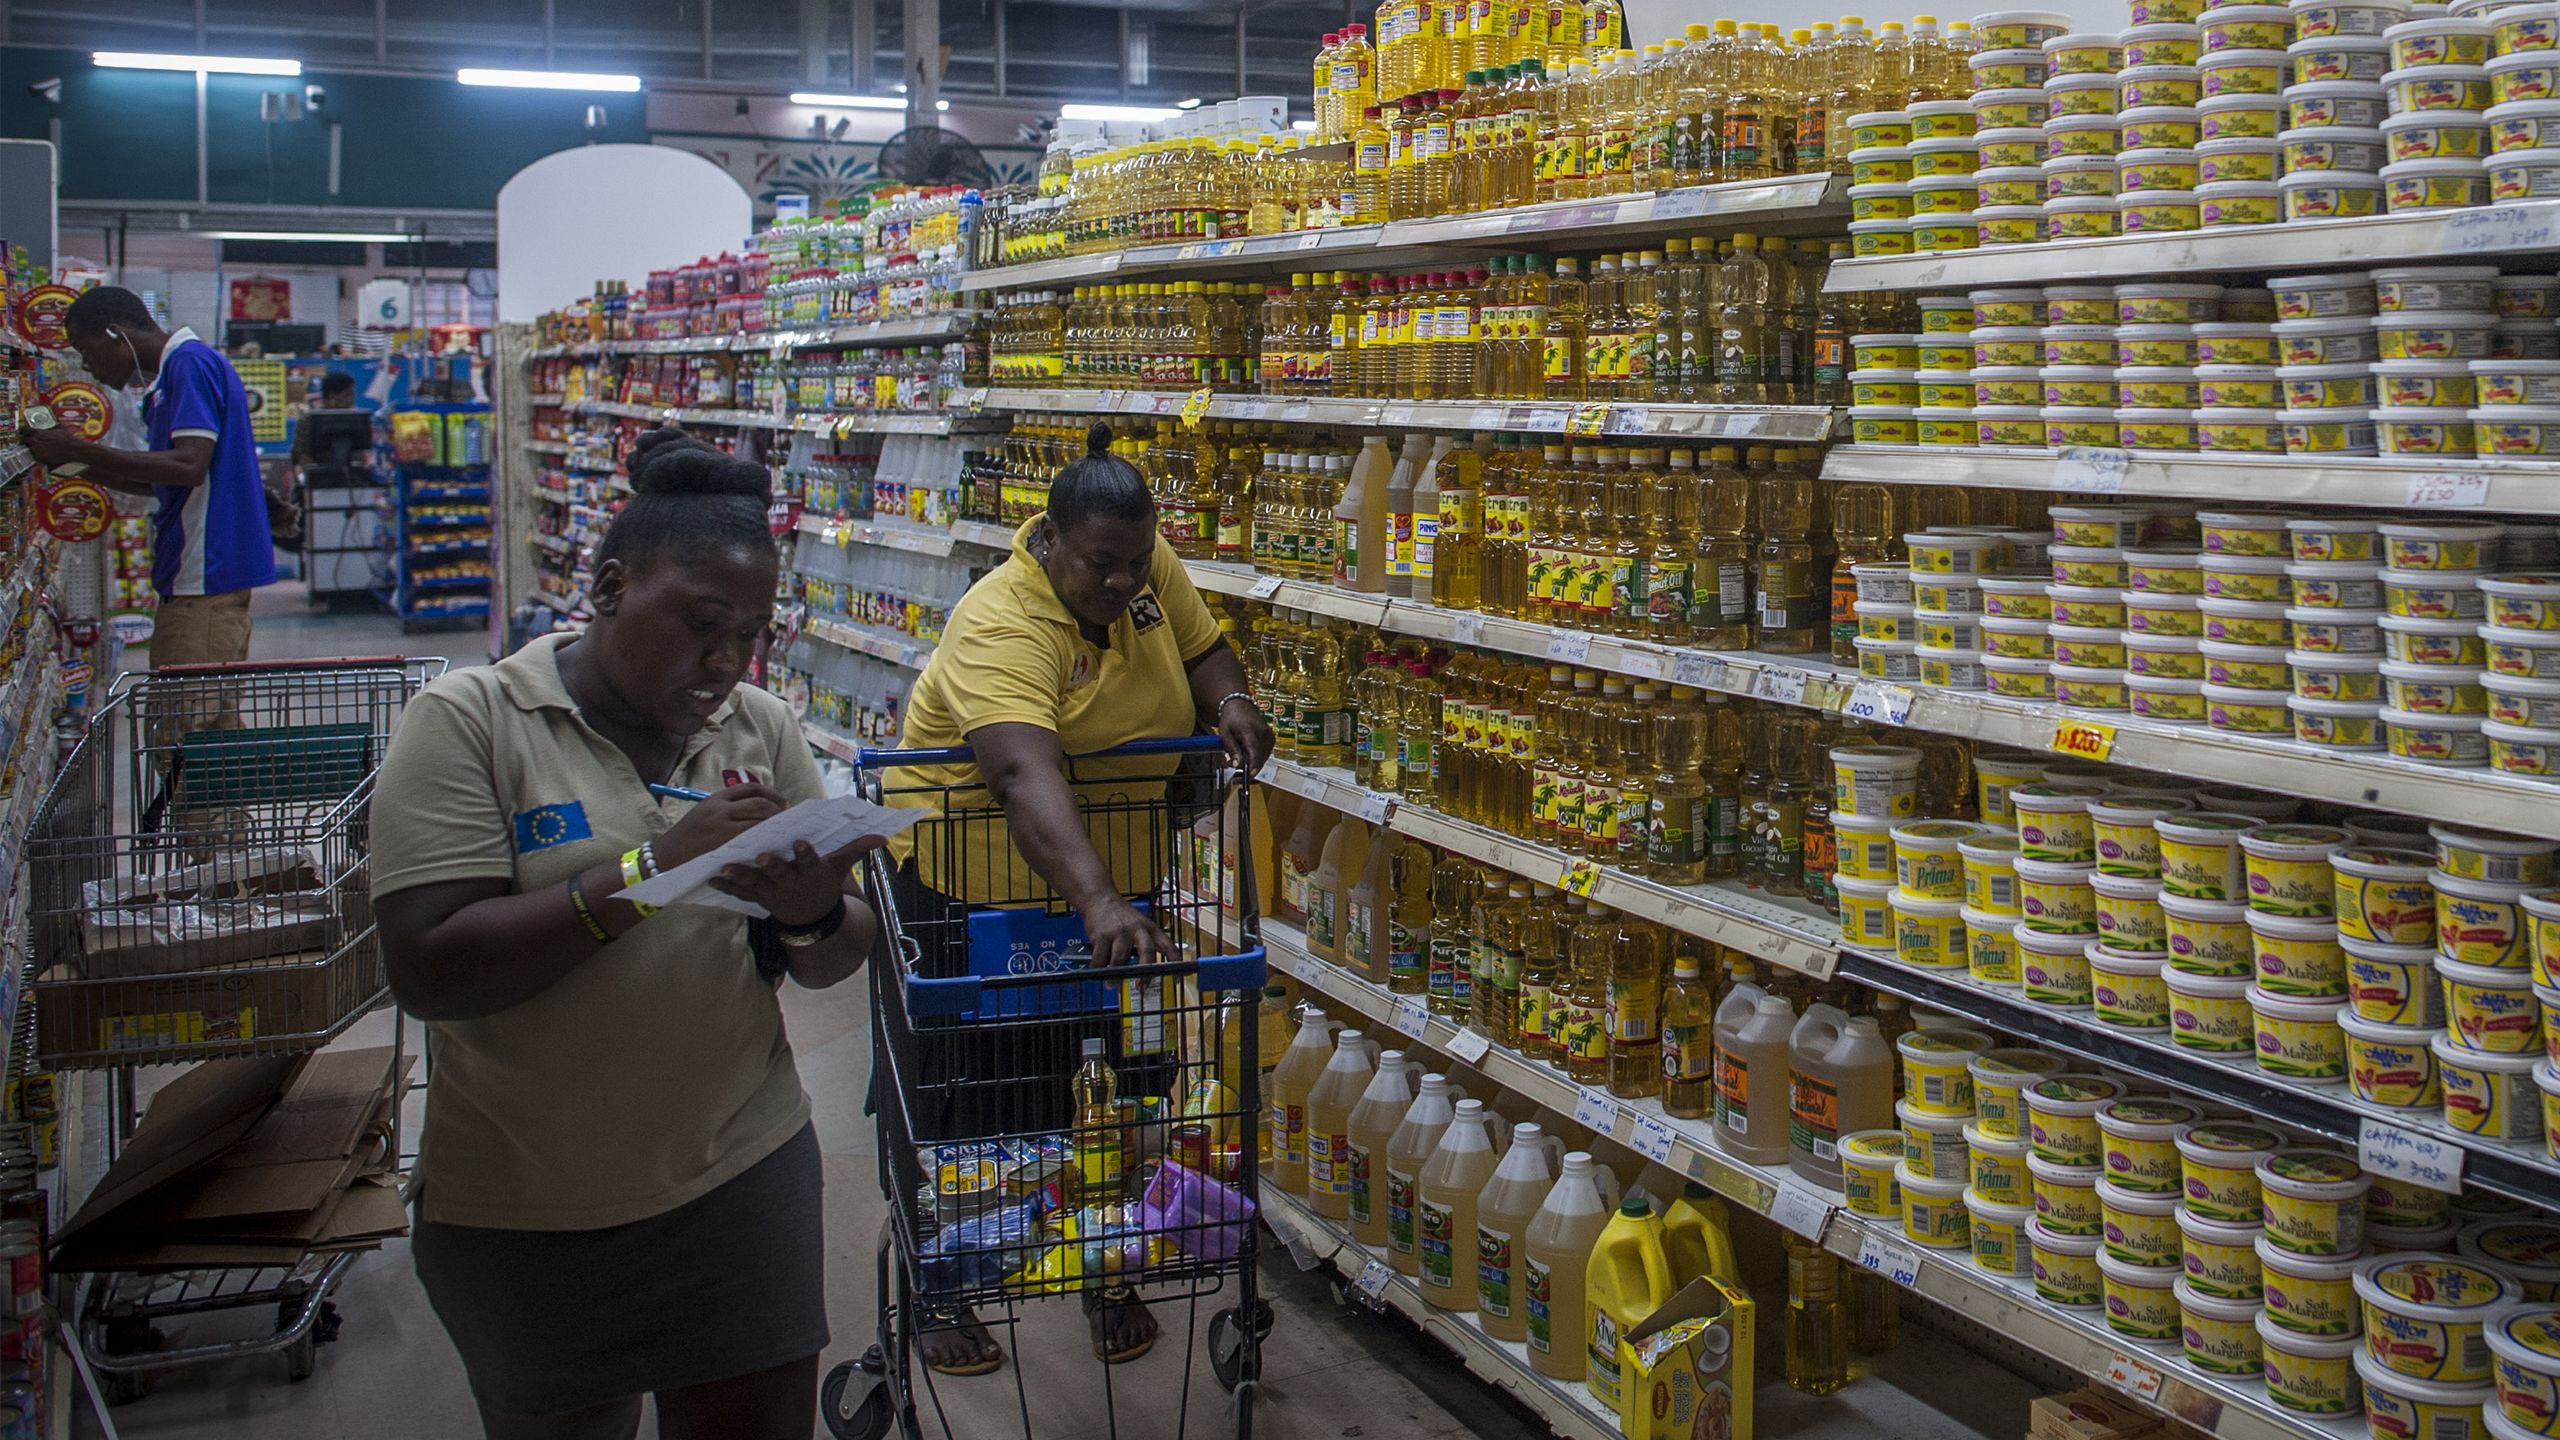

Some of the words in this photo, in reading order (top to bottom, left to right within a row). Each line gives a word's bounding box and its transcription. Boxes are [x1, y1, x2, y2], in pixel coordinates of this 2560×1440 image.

[380, 295, 399, 320] 6
[1419, 523, 1438, 532] PING
[1851, 703, 1873, 716] 200
[2062, 830, 2081, 841] Soft
[1661, 844, 1672, 853] Oil
[1777, 855, 1789, 863] Oil
[2183, 864, 2203, 873] Soft
[1917, 867, 1954, 890] Prima
[2169, 869, 2222, 885] Margarine
[2289, 881, 2312, 891] Soft
[2272, 887, 2328, 902] Margarine
[2060, 902, 2080, 913] Soft
[2131, 918, 2152, 929] Soft
[1900, 926, 1931, 949] Prima
[1010, 942, 1030, 951] YES
[1040, 940, 1055, 949] NO
[2211, 942, 2233, 952] Soft
[1972, 945, 2006, 965] Prima
[2194, 948, 2248, 961] Margarine
[2305, 961, 2328, 973] Soft
[2064, 972, 2084, 982] Soft
[2135, 994, 2156, 1004] Soft
[2216, 1018, 2238, 1028] Soft
[2301, 1042, 2323, 1052] Soft
[2283, 1048, 2339, 1062] Margarine
[2061, 1134, 2082, 1143] Soft
[2048, 1140, 2097, 1152] Margarine
[2109, 1156, 2131, 1168] LASCO
[2149, 1160, 2171, 1169] Soft
[1977, 1168, 2011, 1189] Prima
[2228, 1189, 2250, 1198] Soft
[2065, 1204, 2085, 1213] Soft
[2290, 1217, 2312, 1227] Soft
[2275, 1223, 2331, 1238] Margarine
[2141, 1234, 2162, 1244] Soft
[1974, 1236, 2002, 1256] Prima
[2126, 1241, 2178, 1253] Margarine
[2222, 1265, 2244, 1274] Soft
[2061, 1273, 2082, 1282] Soft
[2048, 1279, 2097, 1291] Margarine
[2146, 1306, 2166, 1316] Soft
[2306, 1301, 2328, 1310] Soft
[2288, 1306, 2345, 1321] Margarine
[2221, 1340, 2243, 1349] Soft
[2300, 1377, 2322, 1387] Soft
[2284, 1383, 2340, 1398] Margarine
[1656, 1385, 1664, 1416] MAGGI
